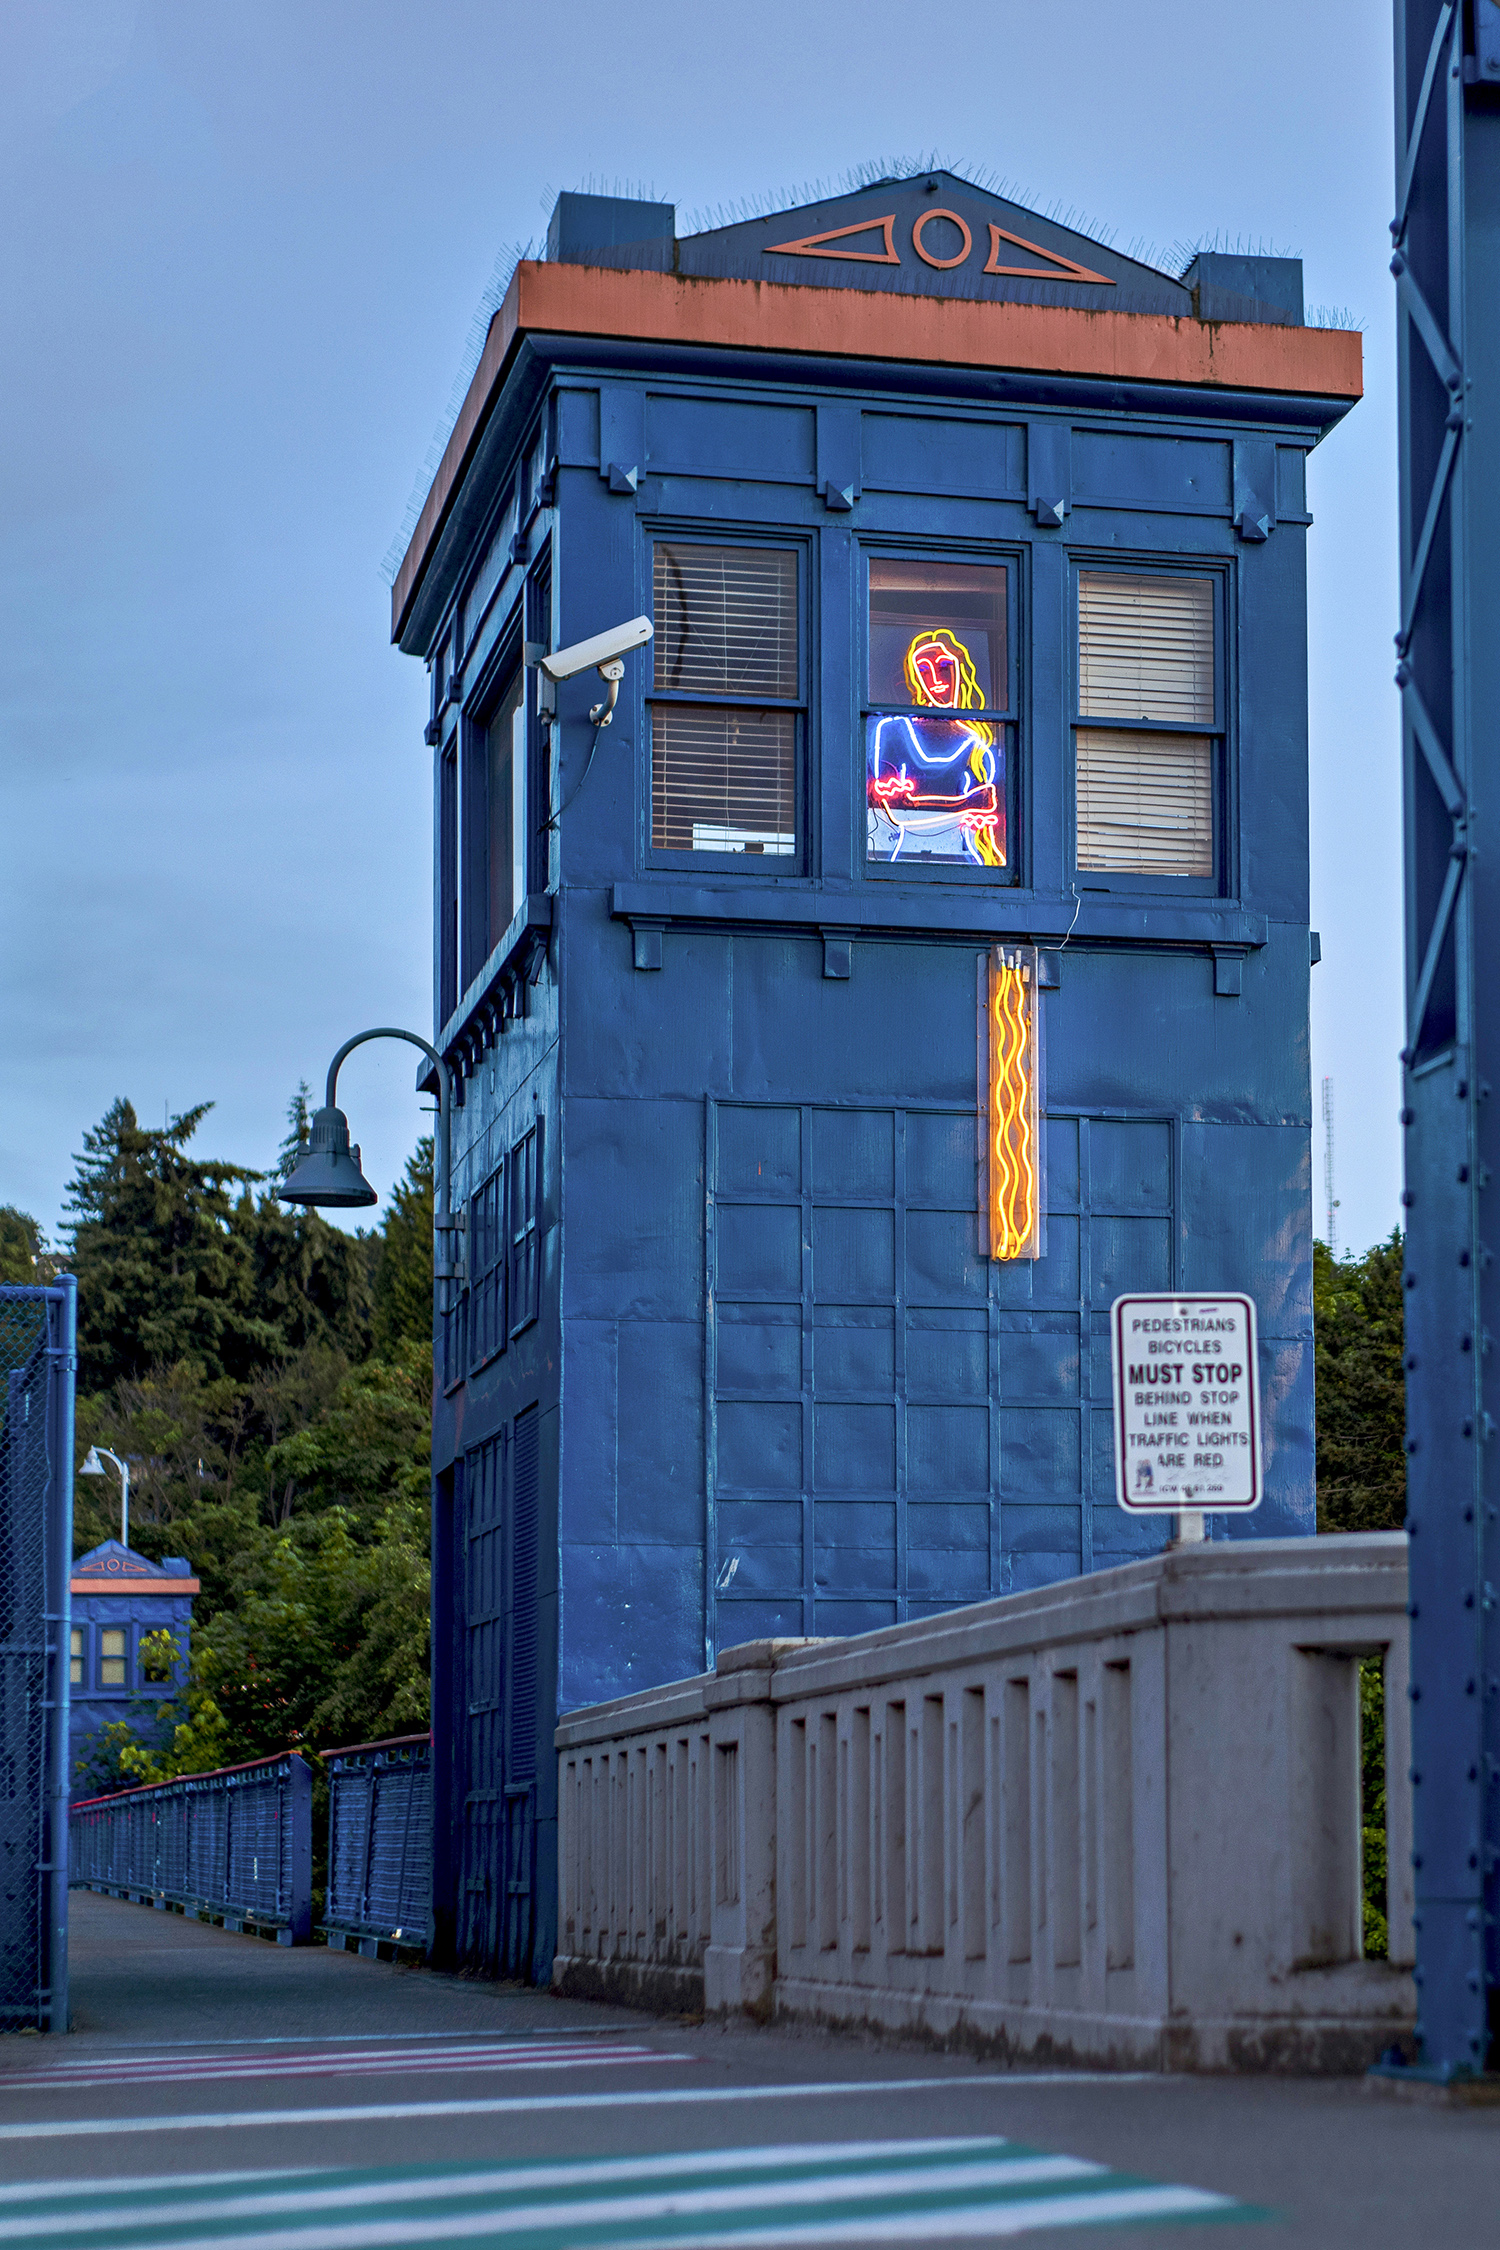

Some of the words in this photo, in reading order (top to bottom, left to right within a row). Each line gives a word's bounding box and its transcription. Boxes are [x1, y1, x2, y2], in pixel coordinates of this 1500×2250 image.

[1132, 1318, 1236, 1332] PEDESTRIANS
[1148, 1340, 1222, 1354] BICYCLES
[1129, 1363, 1184, 1384] MUST
[1192, 1363, 1242, 1384] STOP
[1135, 1391, 1191, 1405] BEHIND
[1200, 1391, 1239, 1405] STOP
[1144, 1411, 1178, 1426] LINE
[1187, 1411, 1232, 1425] WHEN
[1129, 1432, 1190, 1447] TRAFFIC
[1197, 1432, 1249, 1446] LIGHTS
[1158, 1453, 1186, 1467] ARE
[1193, 1453, 1224, 1467] RED
